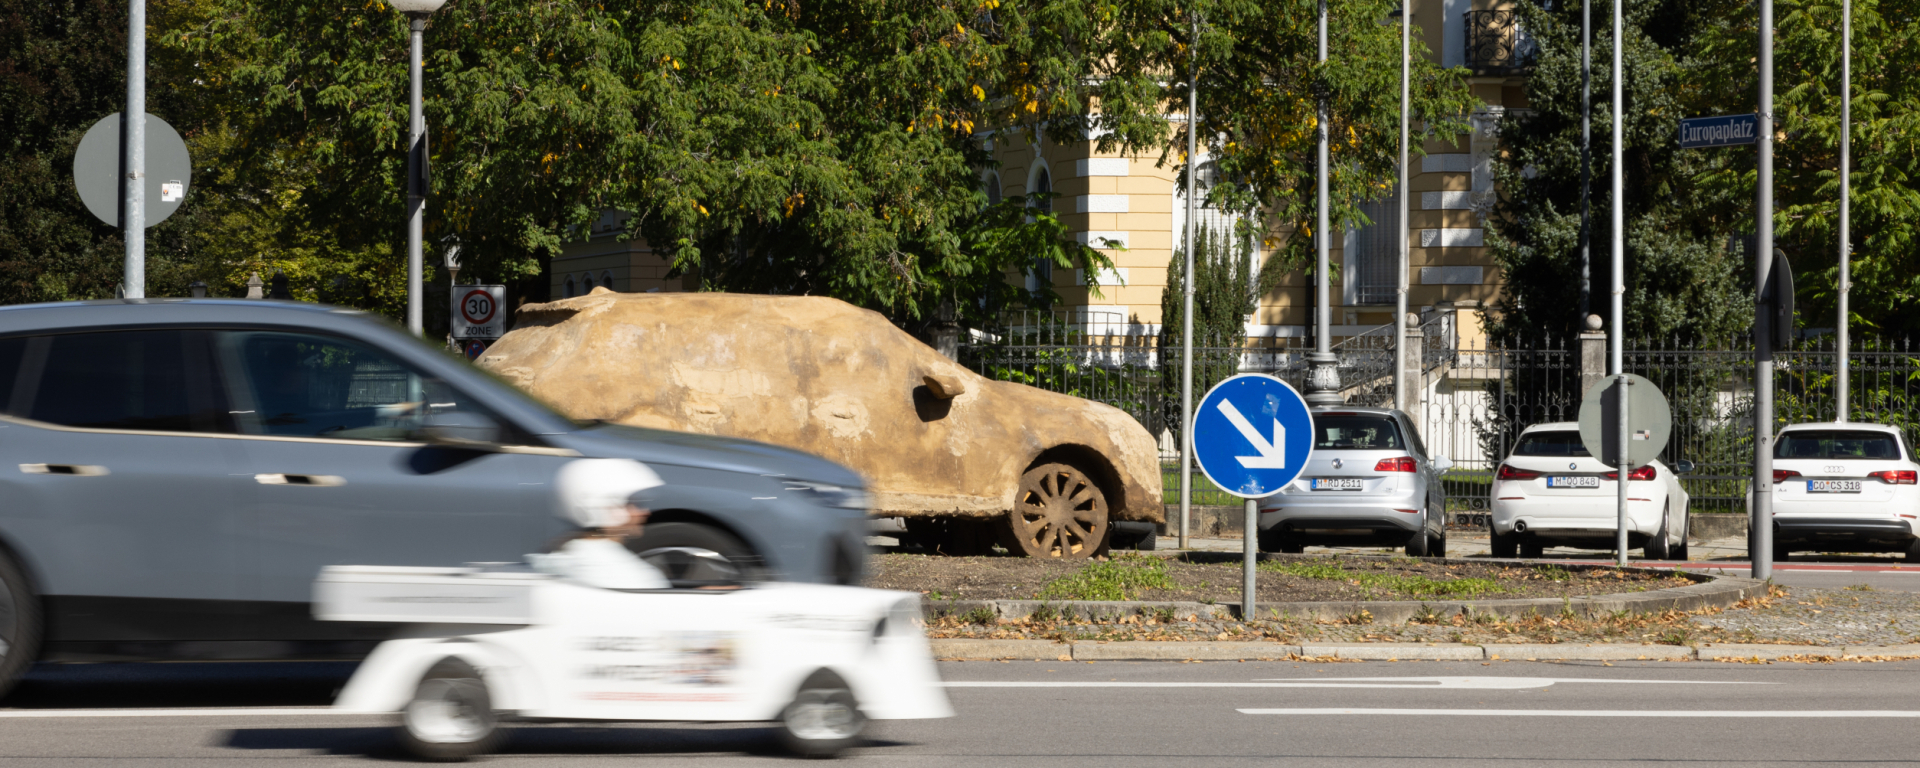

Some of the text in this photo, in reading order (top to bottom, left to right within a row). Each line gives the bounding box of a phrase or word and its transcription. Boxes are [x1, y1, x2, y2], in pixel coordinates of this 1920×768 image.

[1682, 119, 1753, 143] Europaplatz
[468, 299, 489, 315] 30
[465, 327, 491, 335] ZONE
[1328, 479, 1339, 487] RD
[1341, 479, 1361, 487] 2511
[1555, 477, 1561, 485] M
[1813, 481, 1860, 490] CO CS 318
